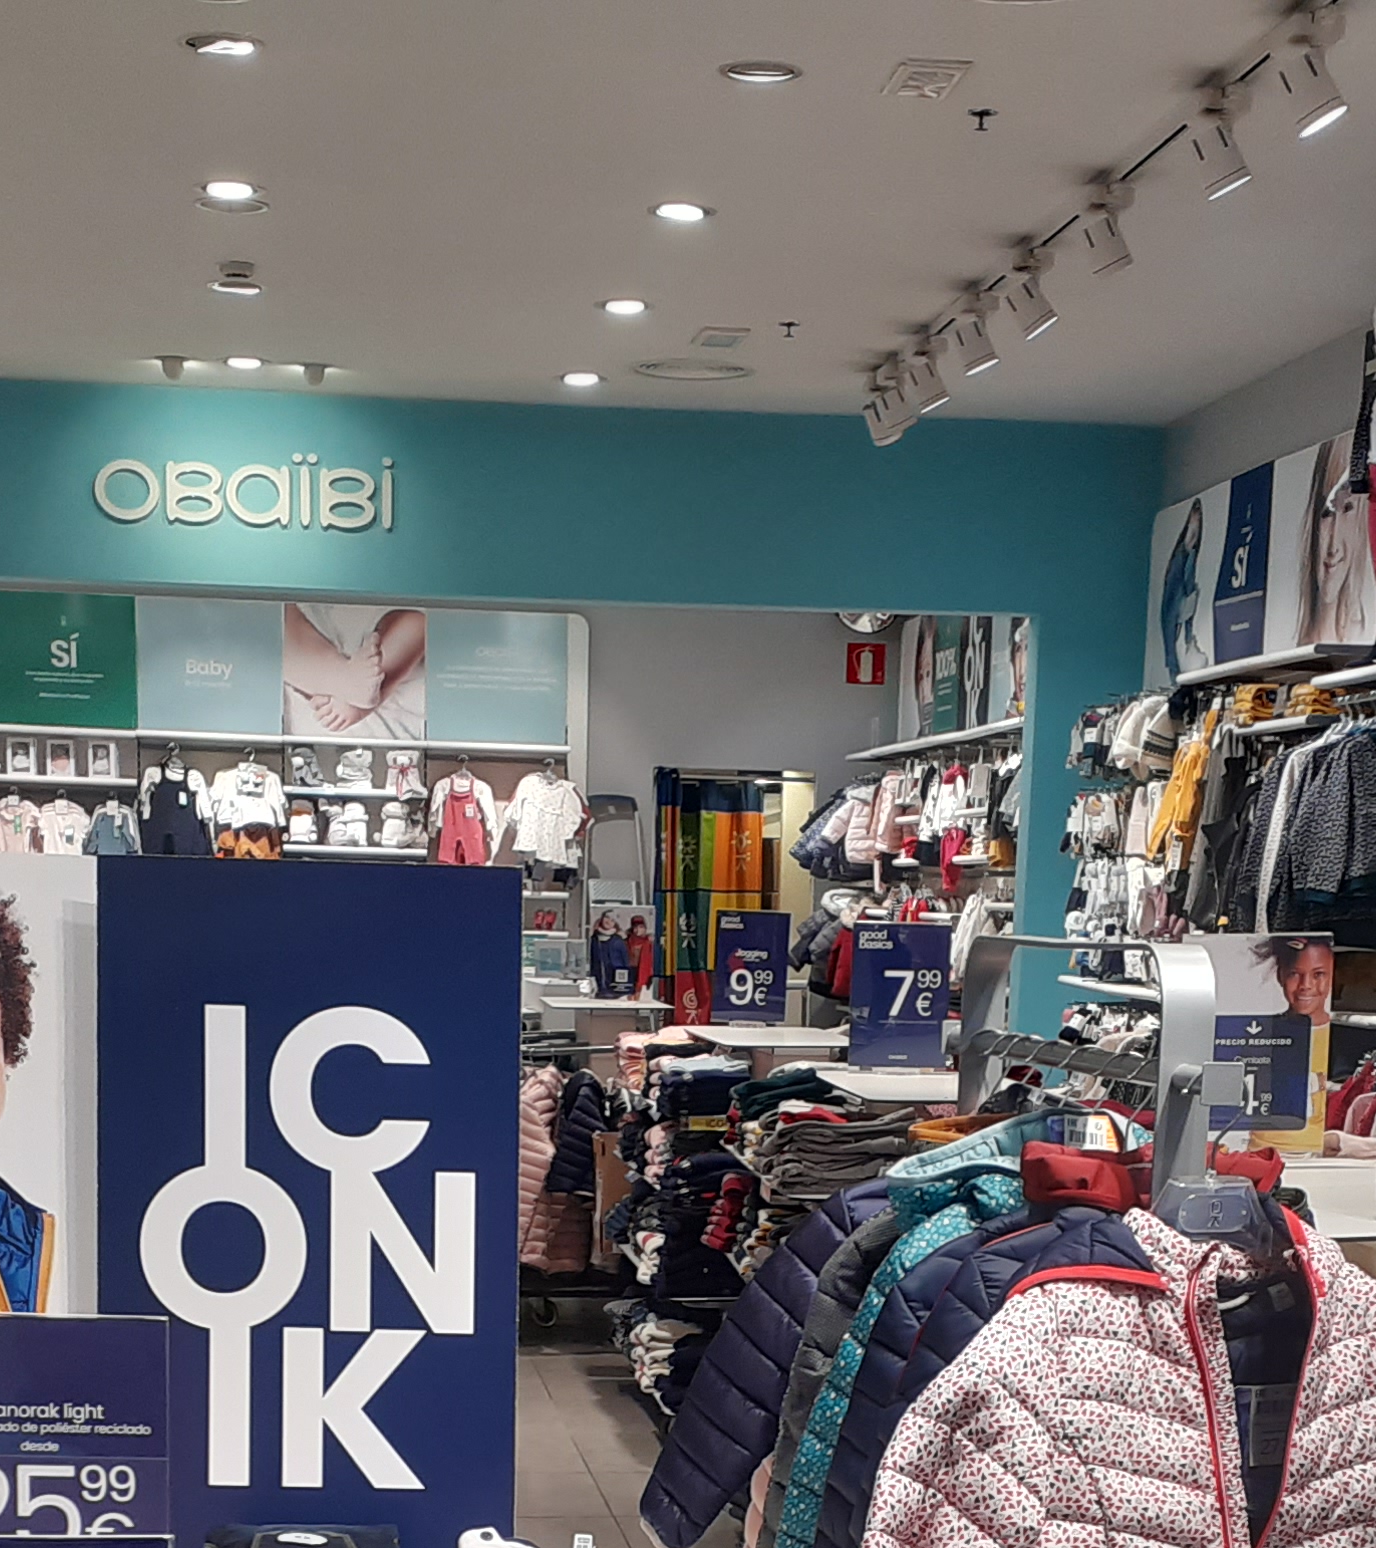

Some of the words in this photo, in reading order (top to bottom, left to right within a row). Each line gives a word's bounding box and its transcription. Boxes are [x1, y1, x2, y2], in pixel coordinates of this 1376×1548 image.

[50, 632, 80, 668] SÍ
[185, 659, 233, 679] Baby
[858, 929, 888, 941] good
[858, 938, 894, 949] basics
[734, 948, 769, 960] Jogging
[729, 968, 754, 1005] 9
[753, 969, 774, 985] 99
[883, 970, 915, 1017] 7
[916, 969, 942, 989] 99
[1215, 1038, 1246, 1046] PRECIO
[1248, 1038, 1293, 1046] REDUCIDO
[63, 1402, 105, 1423] light
[21, 1422, 38, 1433] de
[39, 1422, 91, 1435] poliéster
[93, 1423, 152, 1435] reciclado
[19, 1440, 60, 1452] desde
[79, 1464, 136, 1502] 99
